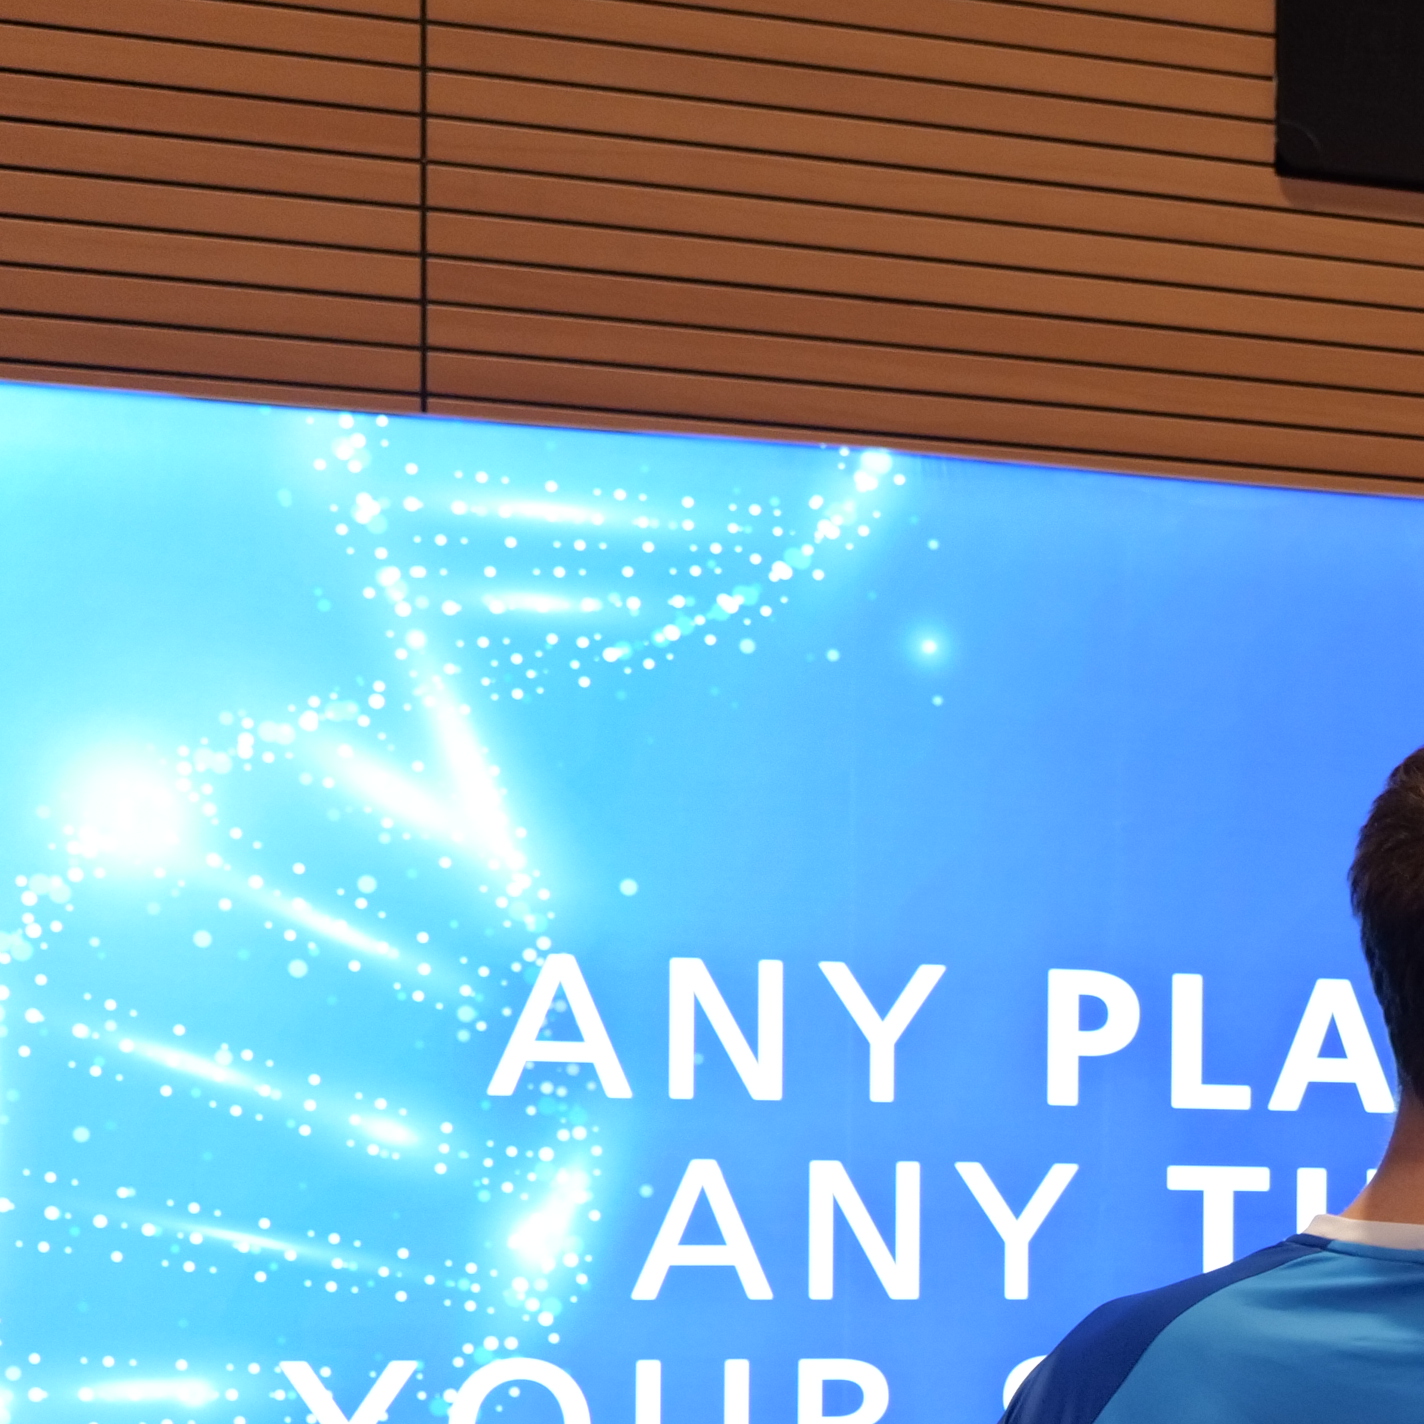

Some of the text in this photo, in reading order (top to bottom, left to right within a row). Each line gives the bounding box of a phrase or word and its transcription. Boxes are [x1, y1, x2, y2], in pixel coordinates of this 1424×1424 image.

[486, 953, 1398, 1114] ANY PLA
[631, 1159, 1079, 1301] ANY
